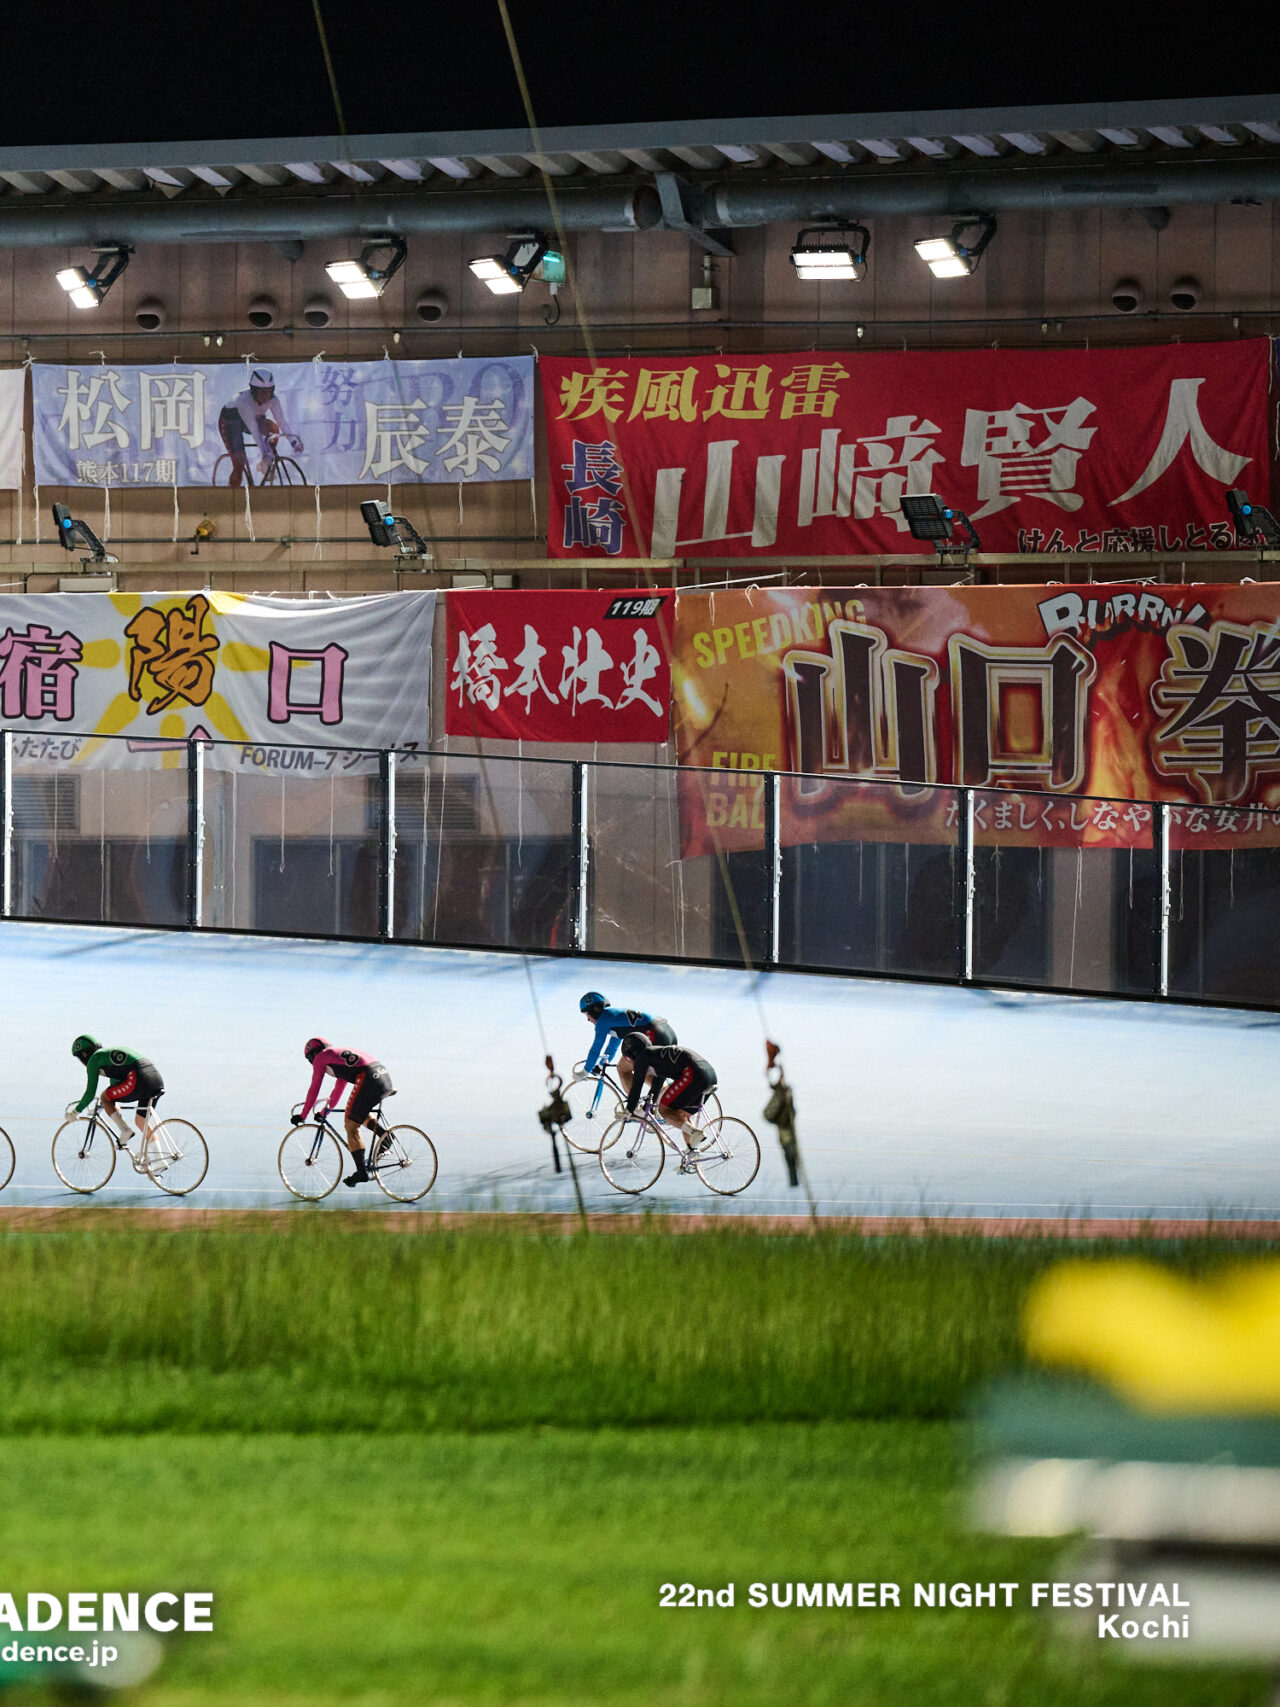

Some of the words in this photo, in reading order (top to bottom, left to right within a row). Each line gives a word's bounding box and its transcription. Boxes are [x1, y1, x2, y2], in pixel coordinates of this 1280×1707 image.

[57, 370, 207, 451] 松岡
[320, 364, 358, 453] 努力
[555, 361, 850, 424] 疾風迅雷
[357, 395, 512, 481] 辰泰
[75, 458, 177, 485] 熊本117期
[561, 438, 627, 556] 長崎
[610, 598, 661, 617] 119期
[692, 599, 868, 669] SPEEDKING
[342, 741, 419, 771] シース
[706, 792, 782, 830] BAL
